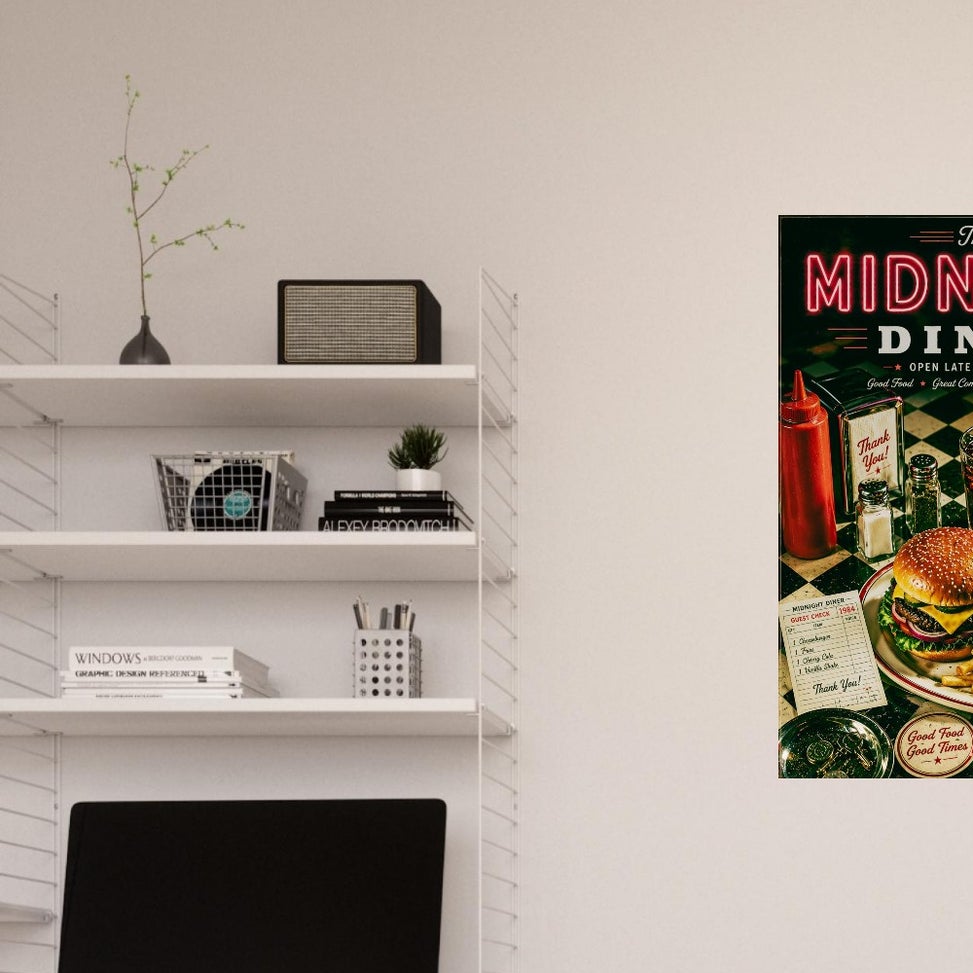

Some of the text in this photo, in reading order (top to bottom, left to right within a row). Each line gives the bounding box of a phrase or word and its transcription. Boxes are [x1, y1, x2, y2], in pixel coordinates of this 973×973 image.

[909, 362, 939, 372] OPEN
[944, 362, 971, 372] LATE
[867, 377, 914, 390] Good Food
[932, 377, 956, 390] Great
[857, 428, 891, 455] Thank
[862, 445, 890, 472] You!
[792, 597, 845, 613] MIDNIGHT DINER
[838, 605, 856, 615] 1984
[790, 611, 831, 624] GUEST CHECK
[75, 652, 142, 665] WINDOWS
[75, 669, 114, 678] GRAPHIC
[115, 670, 147, 678] DESIGN
[812, 675, 861, 695] Thank You!
[907, 726, 965, 743] Good Food
[906, 741, 969, 759] Good Times
